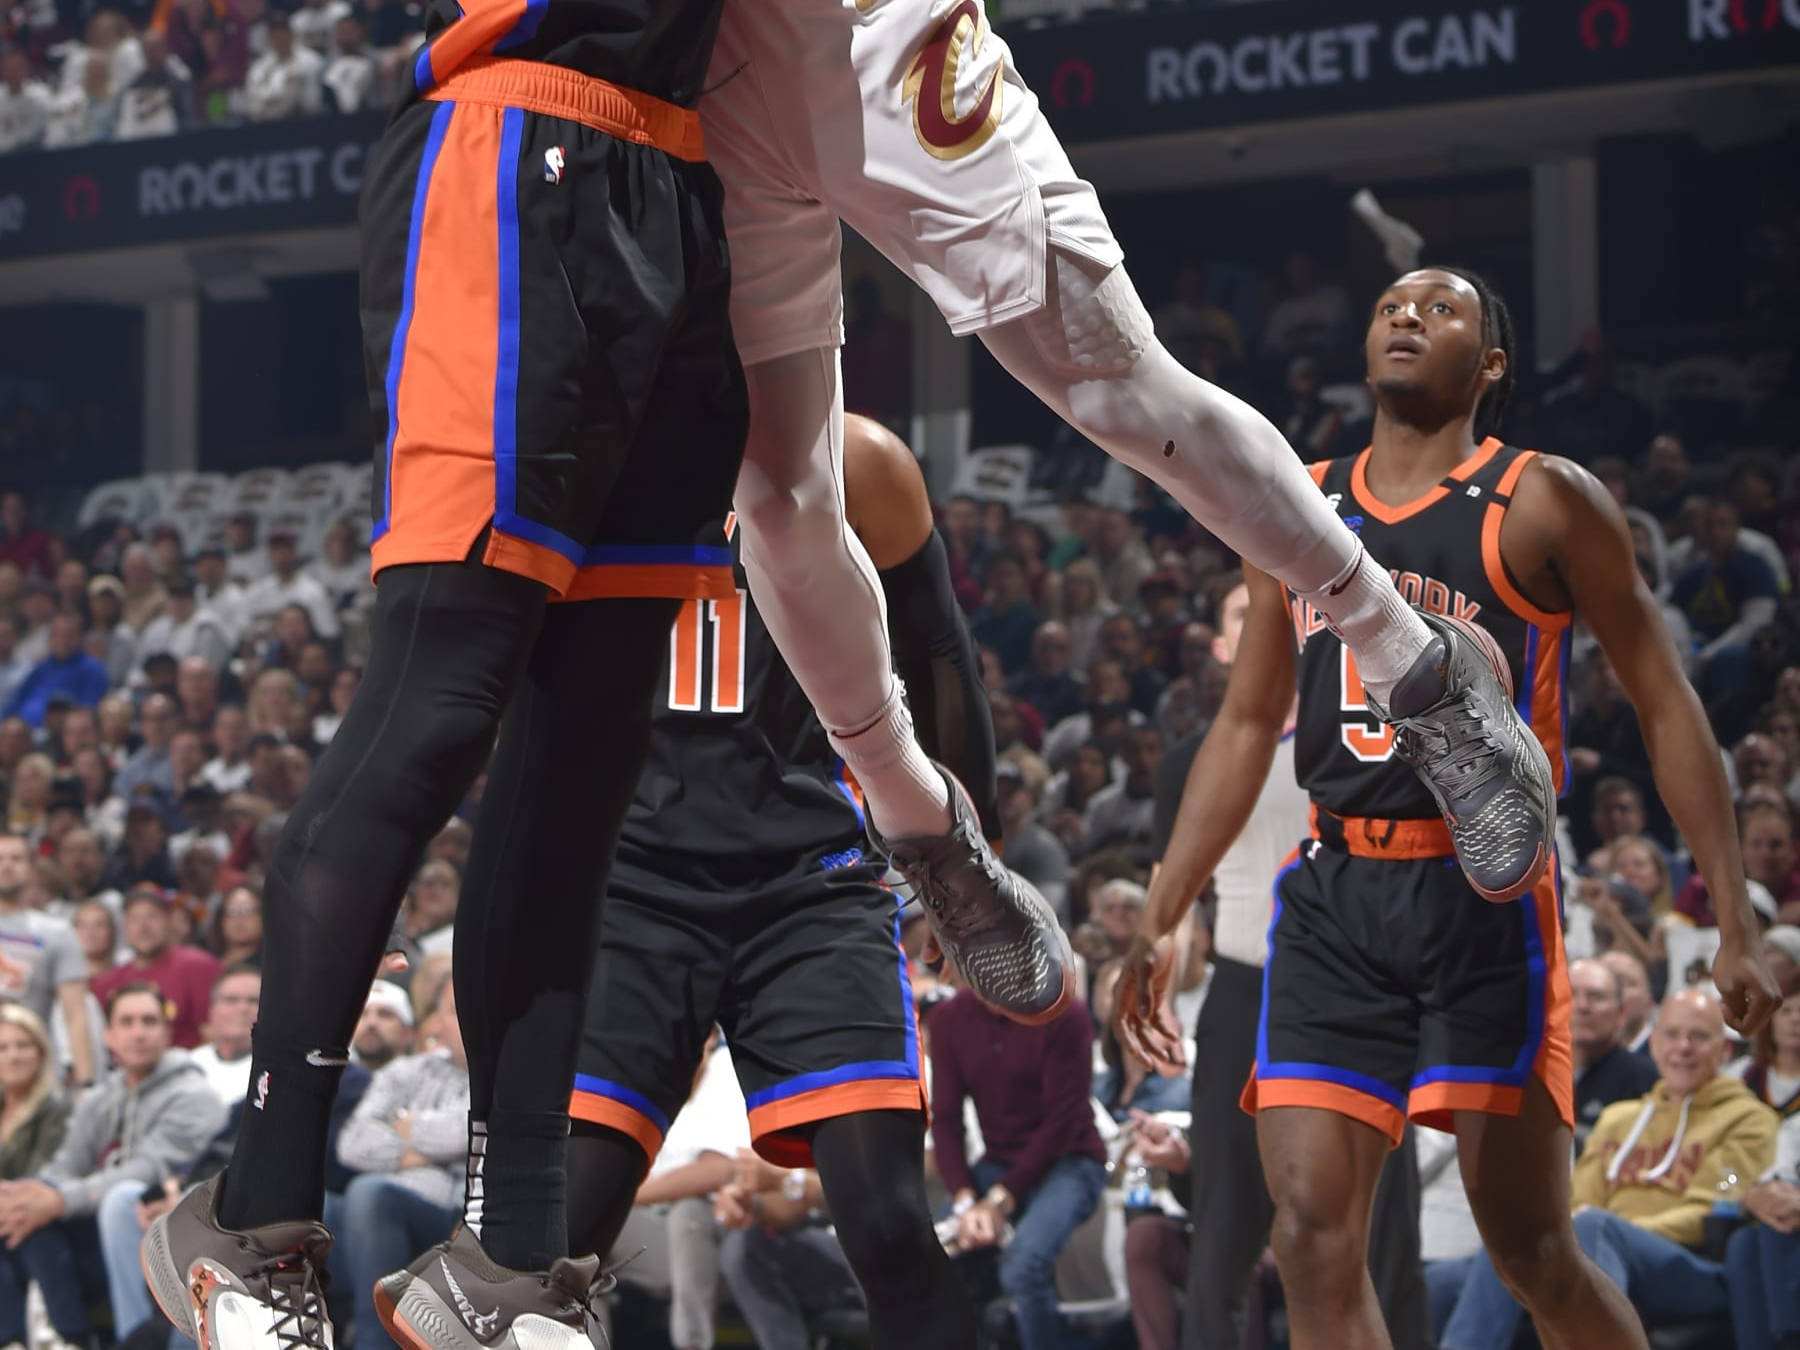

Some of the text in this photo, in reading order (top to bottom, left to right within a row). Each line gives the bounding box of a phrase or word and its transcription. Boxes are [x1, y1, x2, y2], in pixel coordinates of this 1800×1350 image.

[1148, 7, 1516, 104] ROCKET CAN
[139, 151, 324, 216] ROCKET
[1388, 569, 1481, 623] ORK
[668, 588, 747, 713] 11
